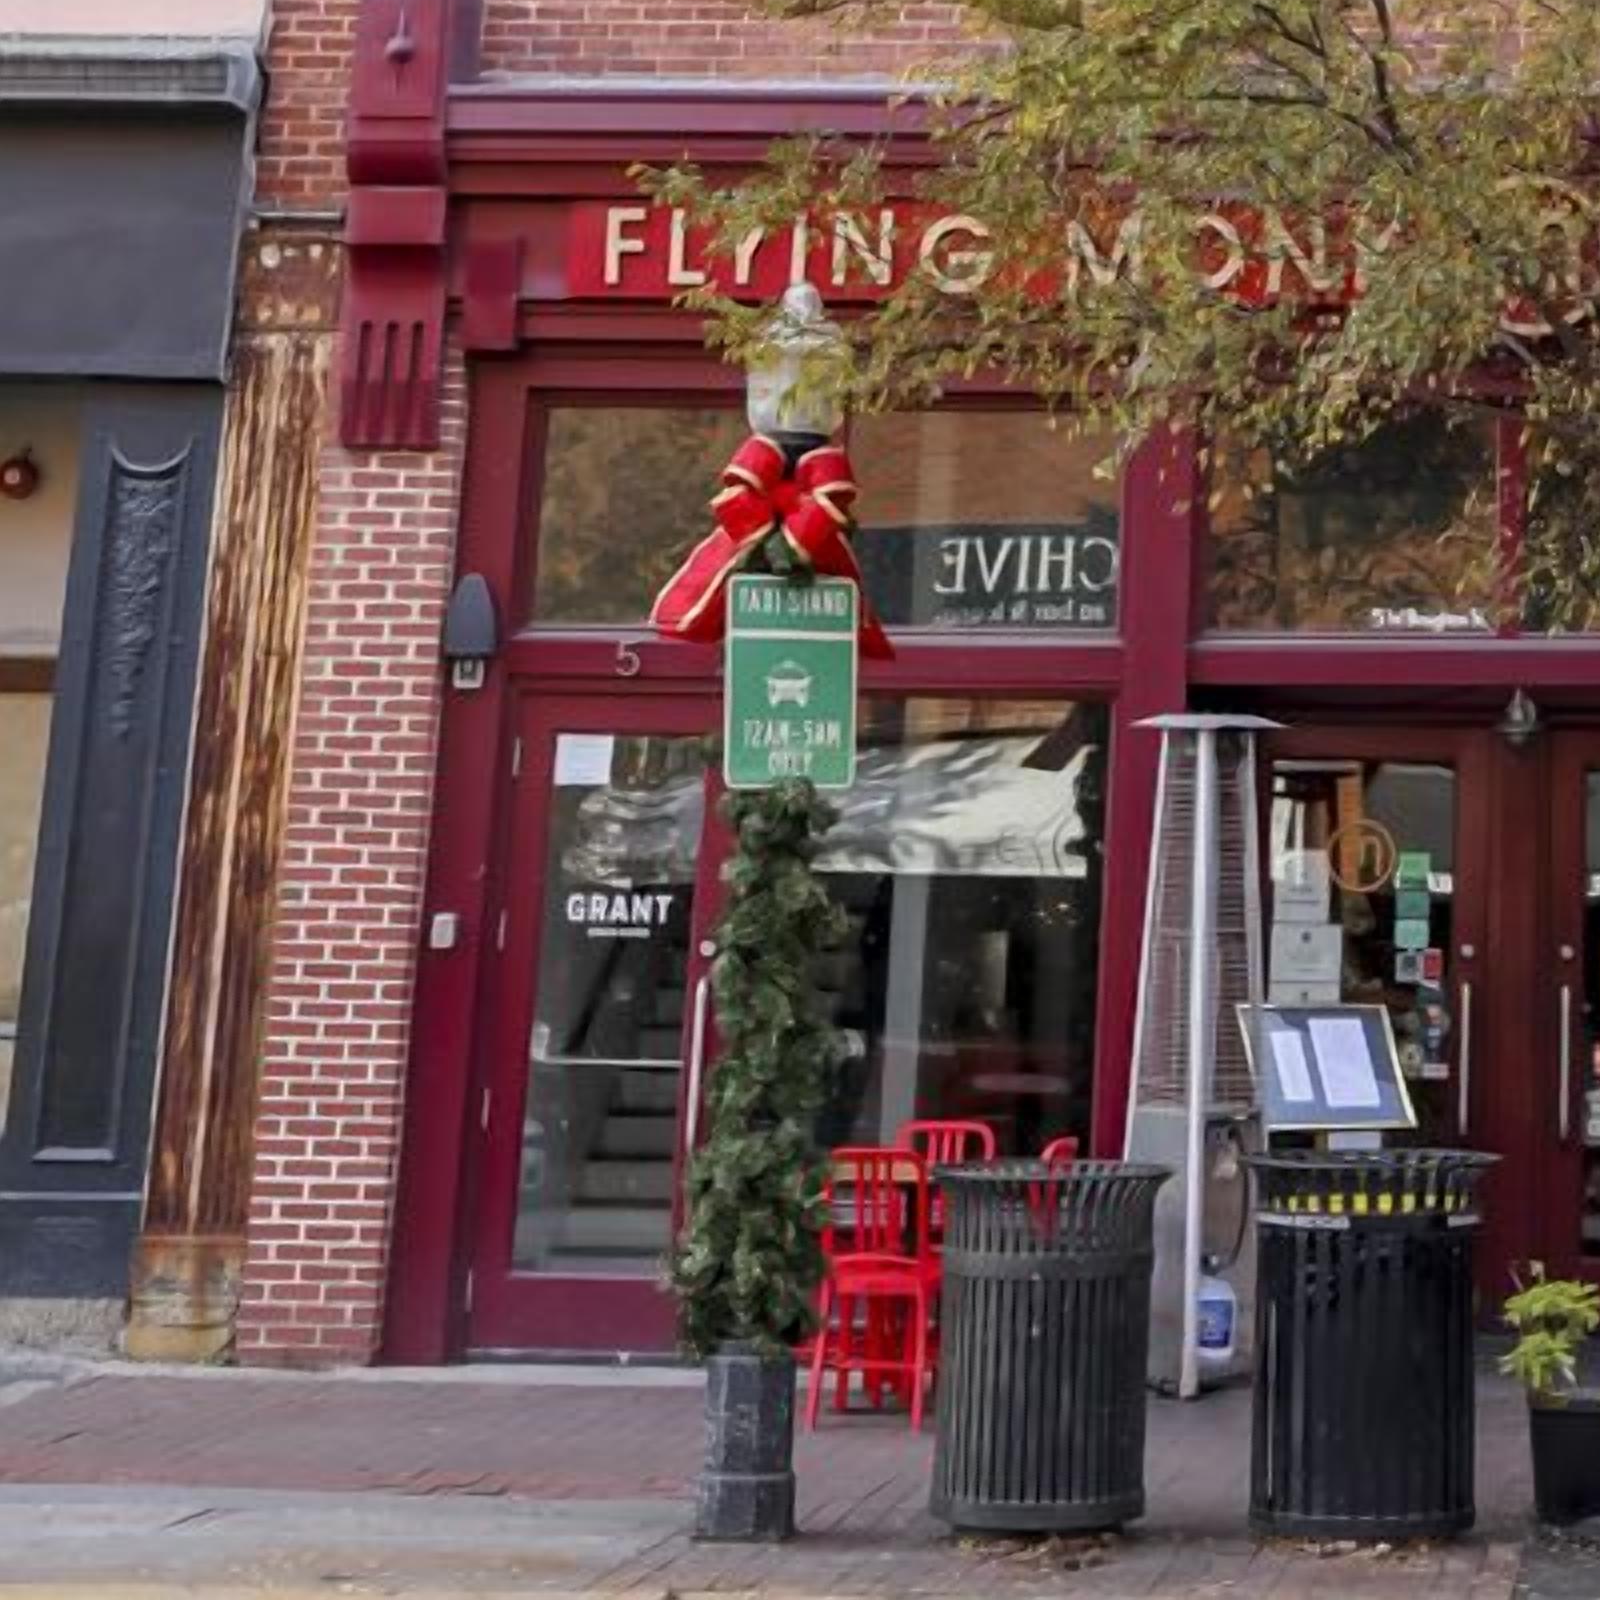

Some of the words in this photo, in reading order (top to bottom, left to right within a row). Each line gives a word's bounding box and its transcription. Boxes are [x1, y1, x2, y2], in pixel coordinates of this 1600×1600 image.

[604, 207, 994, 292] FLYING
[616, 640, 640, 676] 5
[567, 892, 673, 924] GRANT
